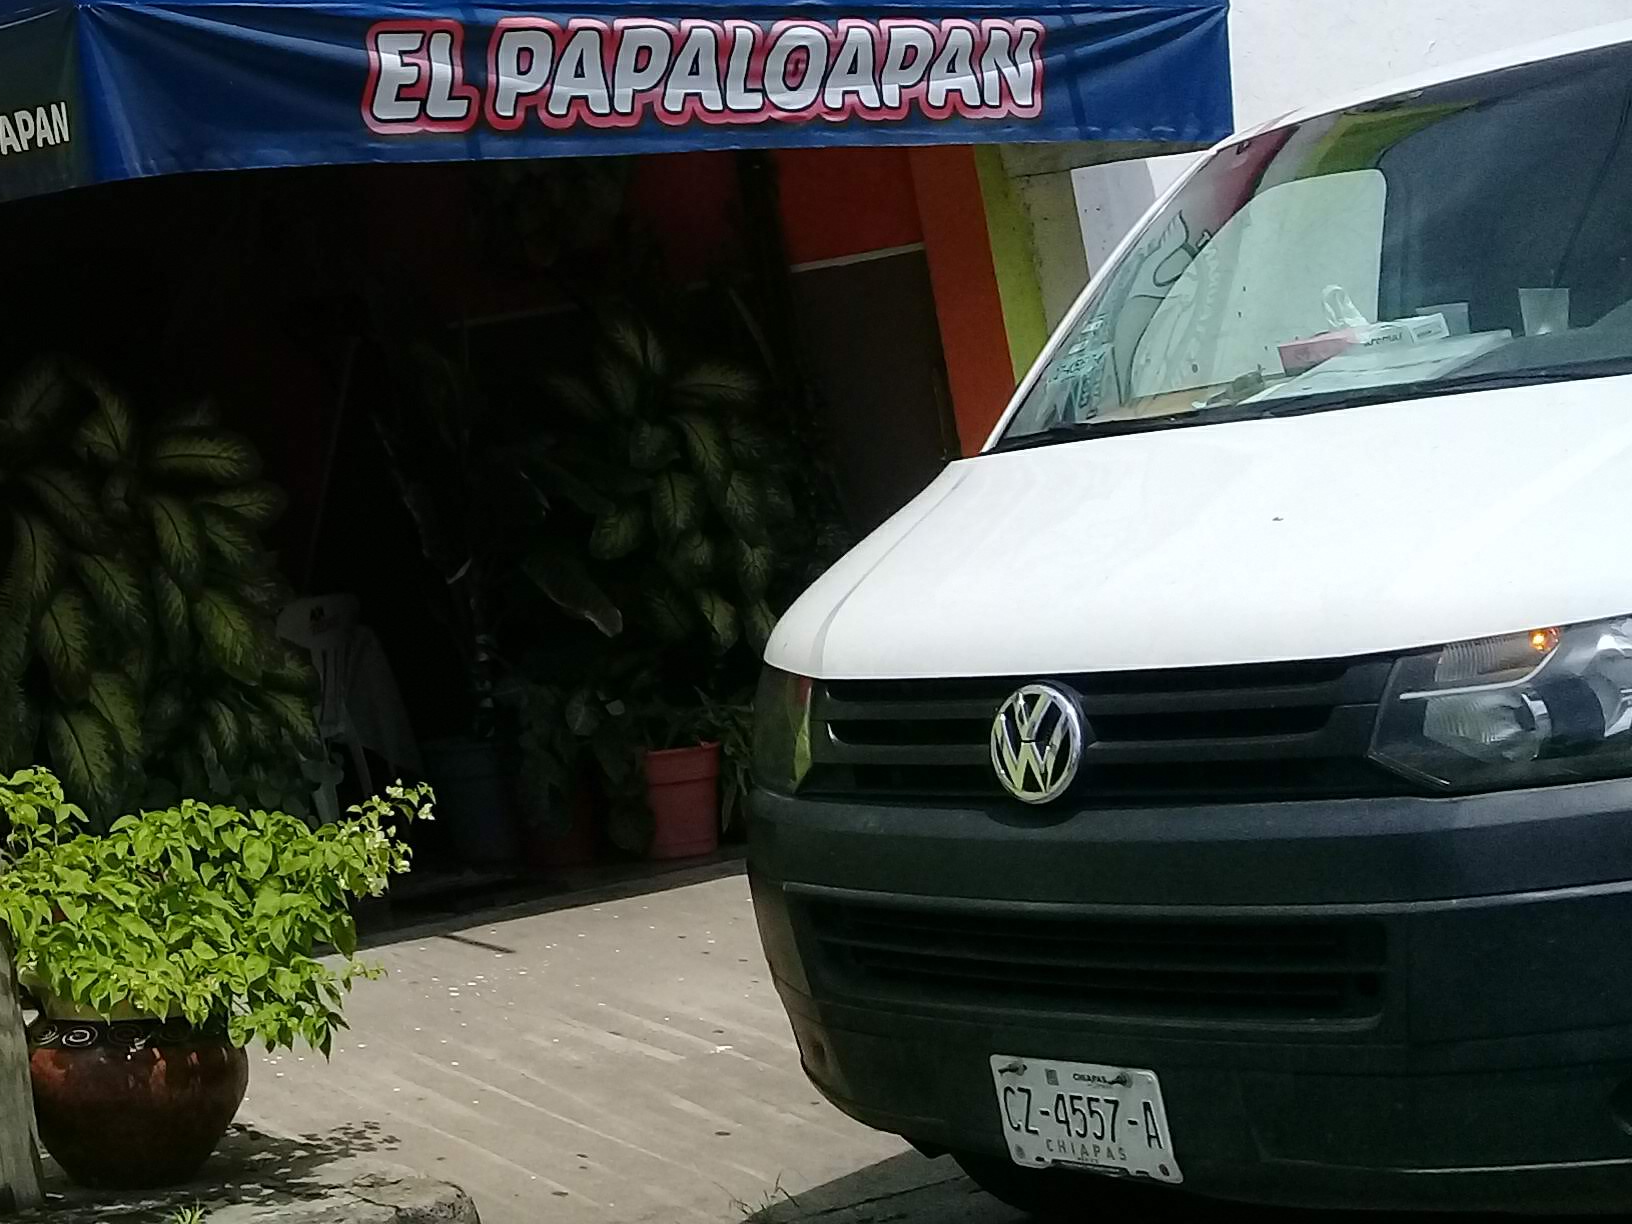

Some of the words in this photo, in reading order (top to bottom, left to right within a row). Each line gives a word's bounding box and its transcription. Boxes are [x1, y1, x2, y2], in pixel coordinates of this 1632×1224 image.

[369, 26, 472, 125] EL
[491, 24, 1039, 120] PAPALOAPAN
[1003, 1086, 1164, 1150] CZ-4557-A
[1045, 1138, 1129, 1162] CHIAPAS
